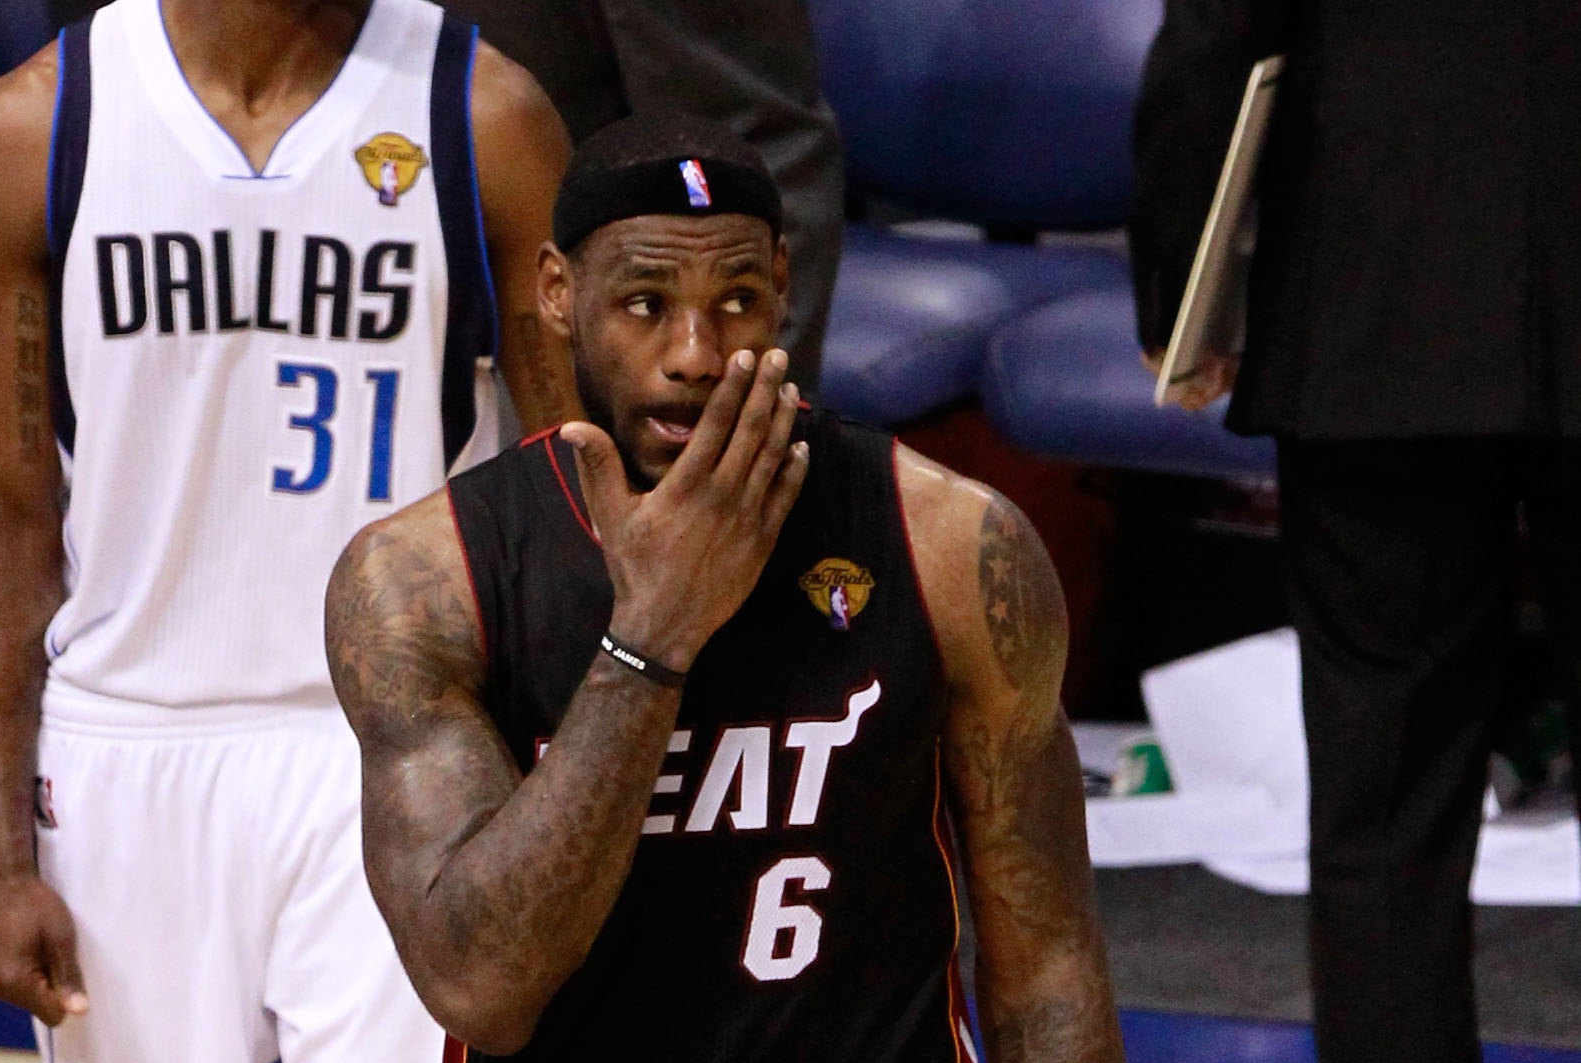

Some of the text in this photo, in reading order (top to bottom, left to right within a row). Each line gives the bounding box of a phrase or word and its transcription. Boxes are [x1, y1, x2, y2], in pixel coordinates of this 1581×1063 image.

[95, 229, 417, 343] DALLAS
[272, 361, 400, 502] 31
[613, 647, 646, 670] JAMES
[535, 679, 882, 835] EAT
[742, 856, 833, 982] 6
